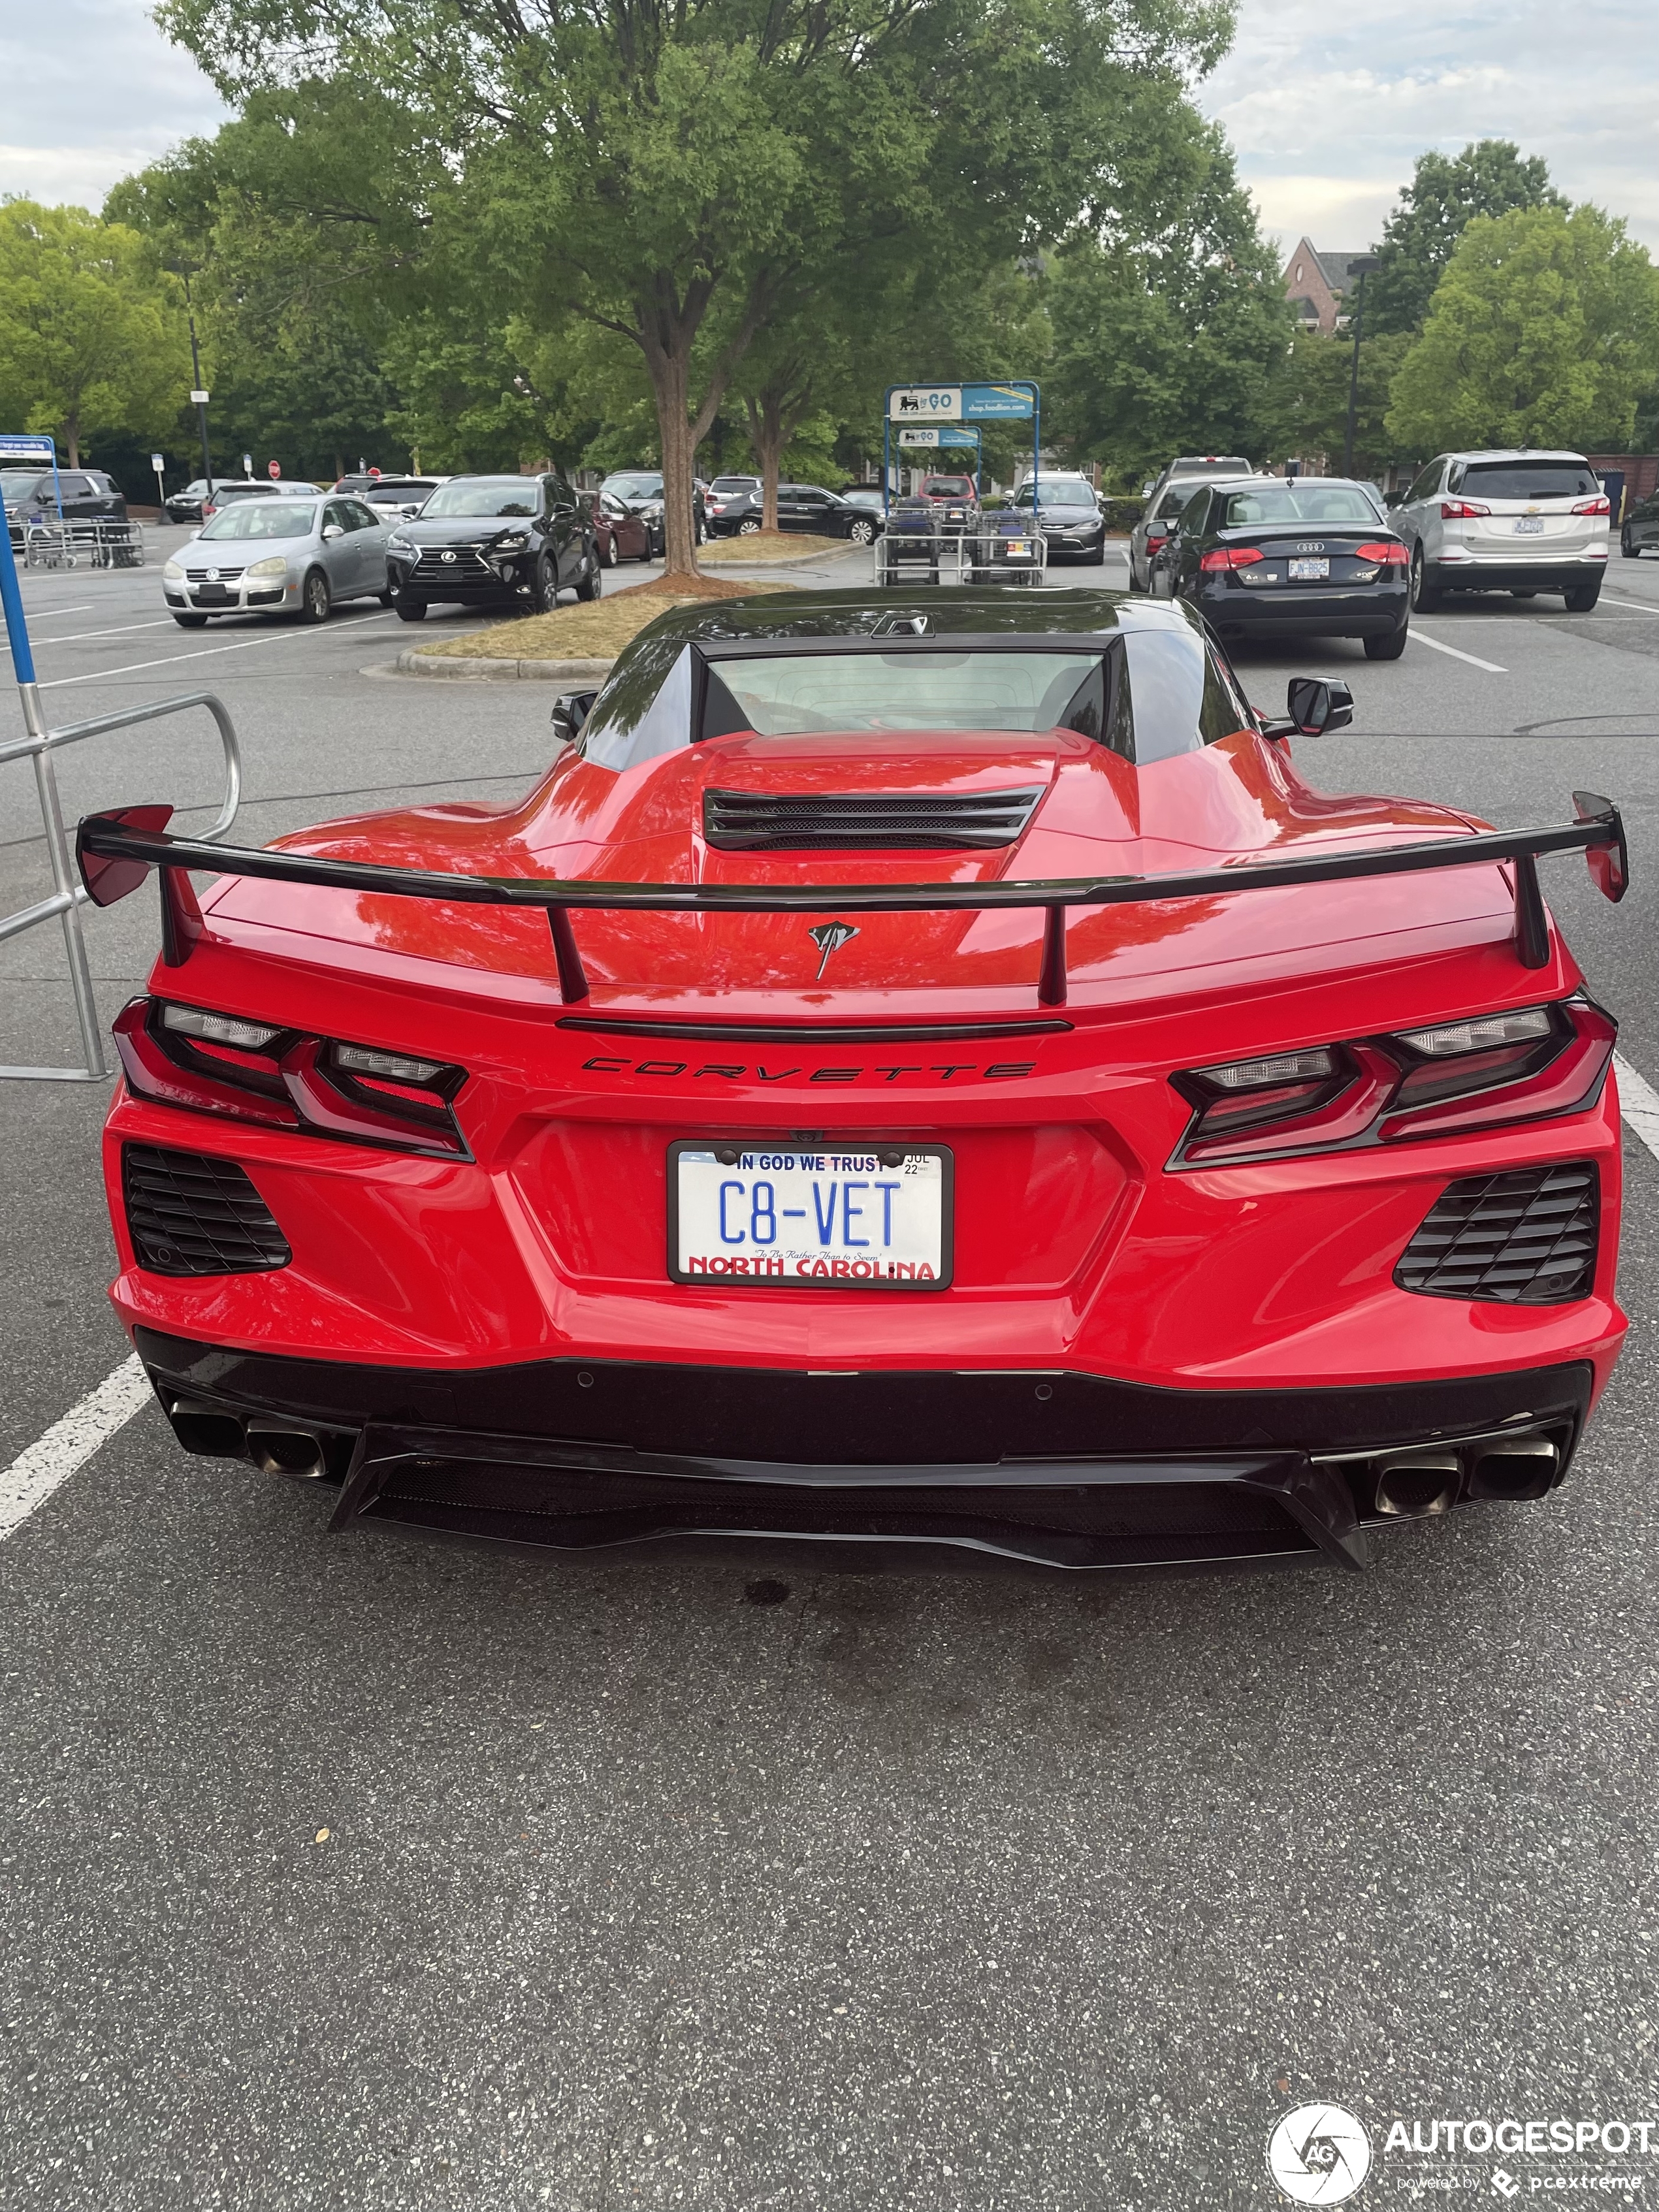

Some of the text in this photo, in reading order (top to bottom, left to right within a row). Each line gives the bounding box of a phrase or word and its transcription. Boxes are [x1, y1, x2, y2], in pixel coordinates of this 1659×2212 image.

[929, 393, 952, 411] GO
[1290, 562, 1328, 574] FJN-8825
[581, 1056, 1038, 1082] CORVETTE
[737, 1155, 754, 1170] IN
[759, 1155, 795, 1170] GOD
[800, 1155, 826, 1171] WE
[905, 1164, 918, 1174] 22
[720, 1180, 901, 1247] C8-VET
[769, 1249, 783, 1258] Be
[784, 1250, 816, 1259] Rather
[818, 1251, 841, 1260] Than
[689, 1256, 935, 1280] NORTH CAROLINA
